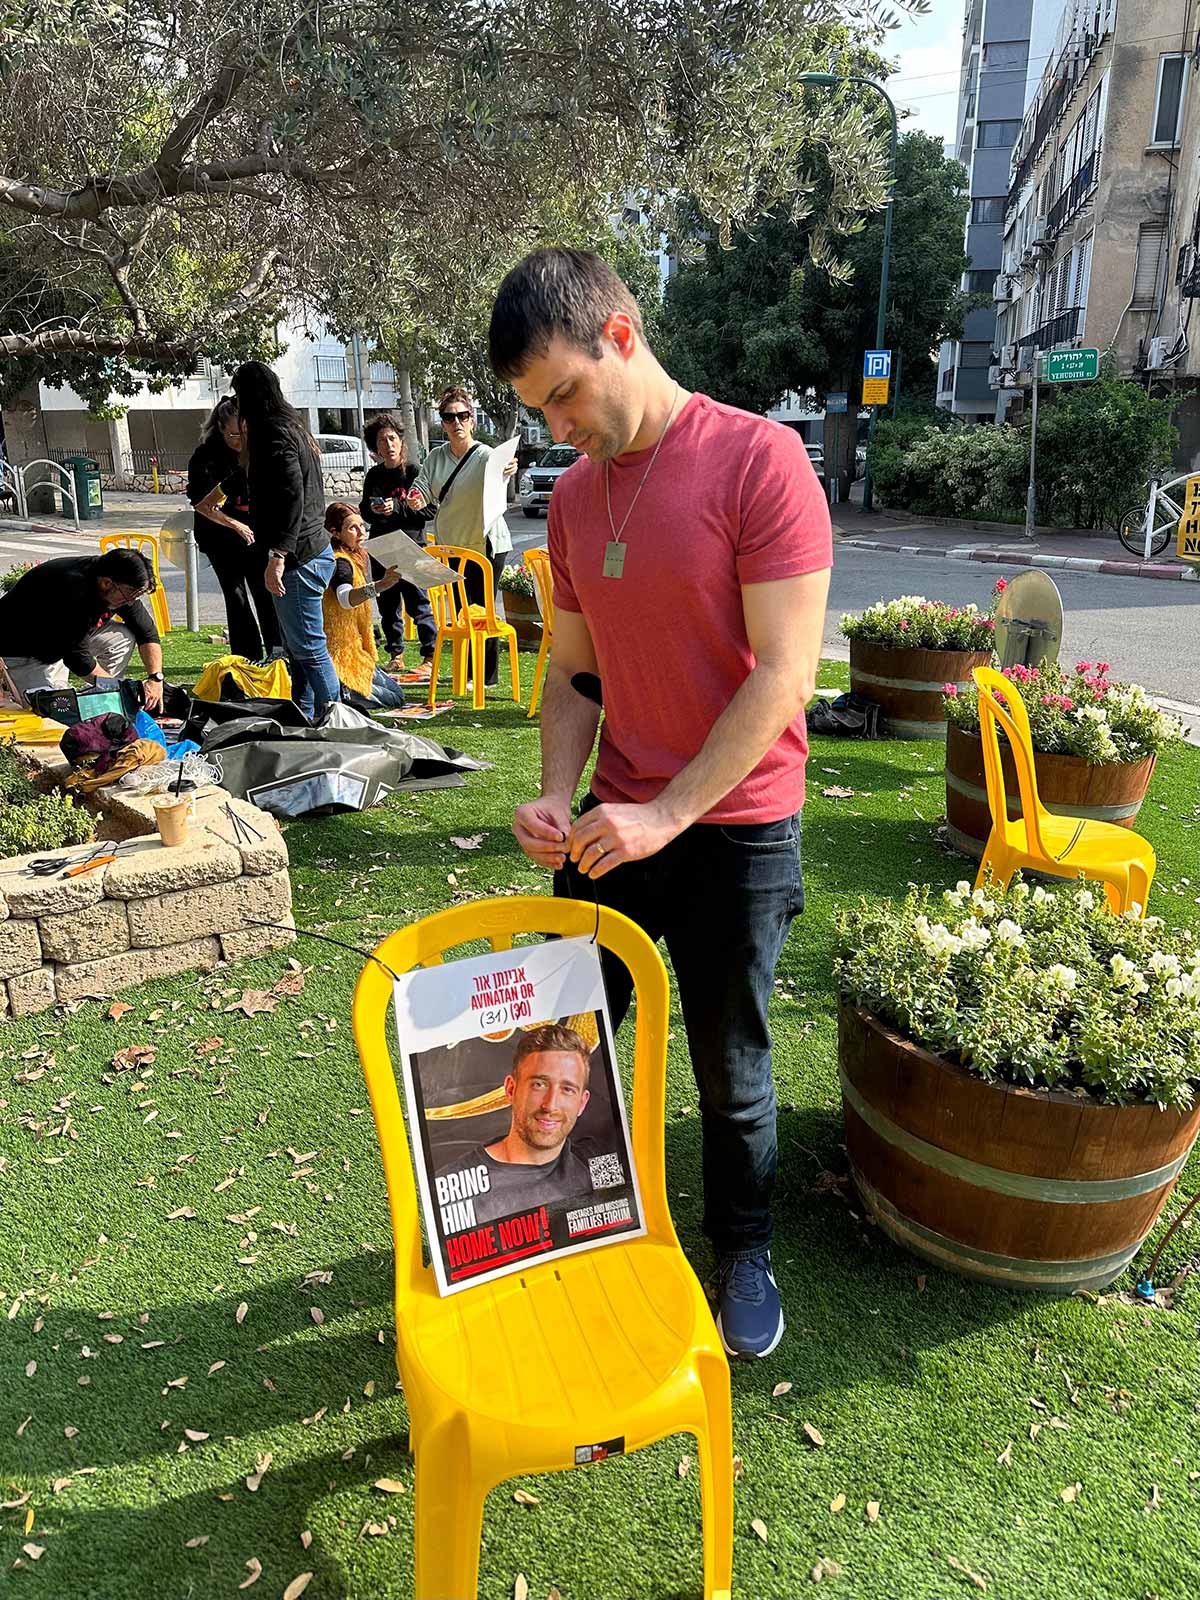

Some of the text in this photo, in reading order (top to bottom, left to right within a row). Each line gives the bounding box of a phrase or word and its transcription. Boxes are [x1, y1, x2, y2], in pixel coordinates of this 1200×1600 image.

[1051, 352, 1083, 361] יהודית
[1051, 371, 1084, 379] YEHUDITH
[472, 967, 527, 992] אבינתן אור
[471, 983, 535, 1011] AVINATAN OR
[480, 1007, 508, 1029] (31)
[434, 1164, 491, 1206] BRING
[439, 1198, 477, 1236] HIM
[566, 1197, 629, 1221] HOSTAGES AND MISSING
[568, 1206, 631, 1234] FAMILIES FORUM
[446, 1206, 551, 1268] HOME NOW!
